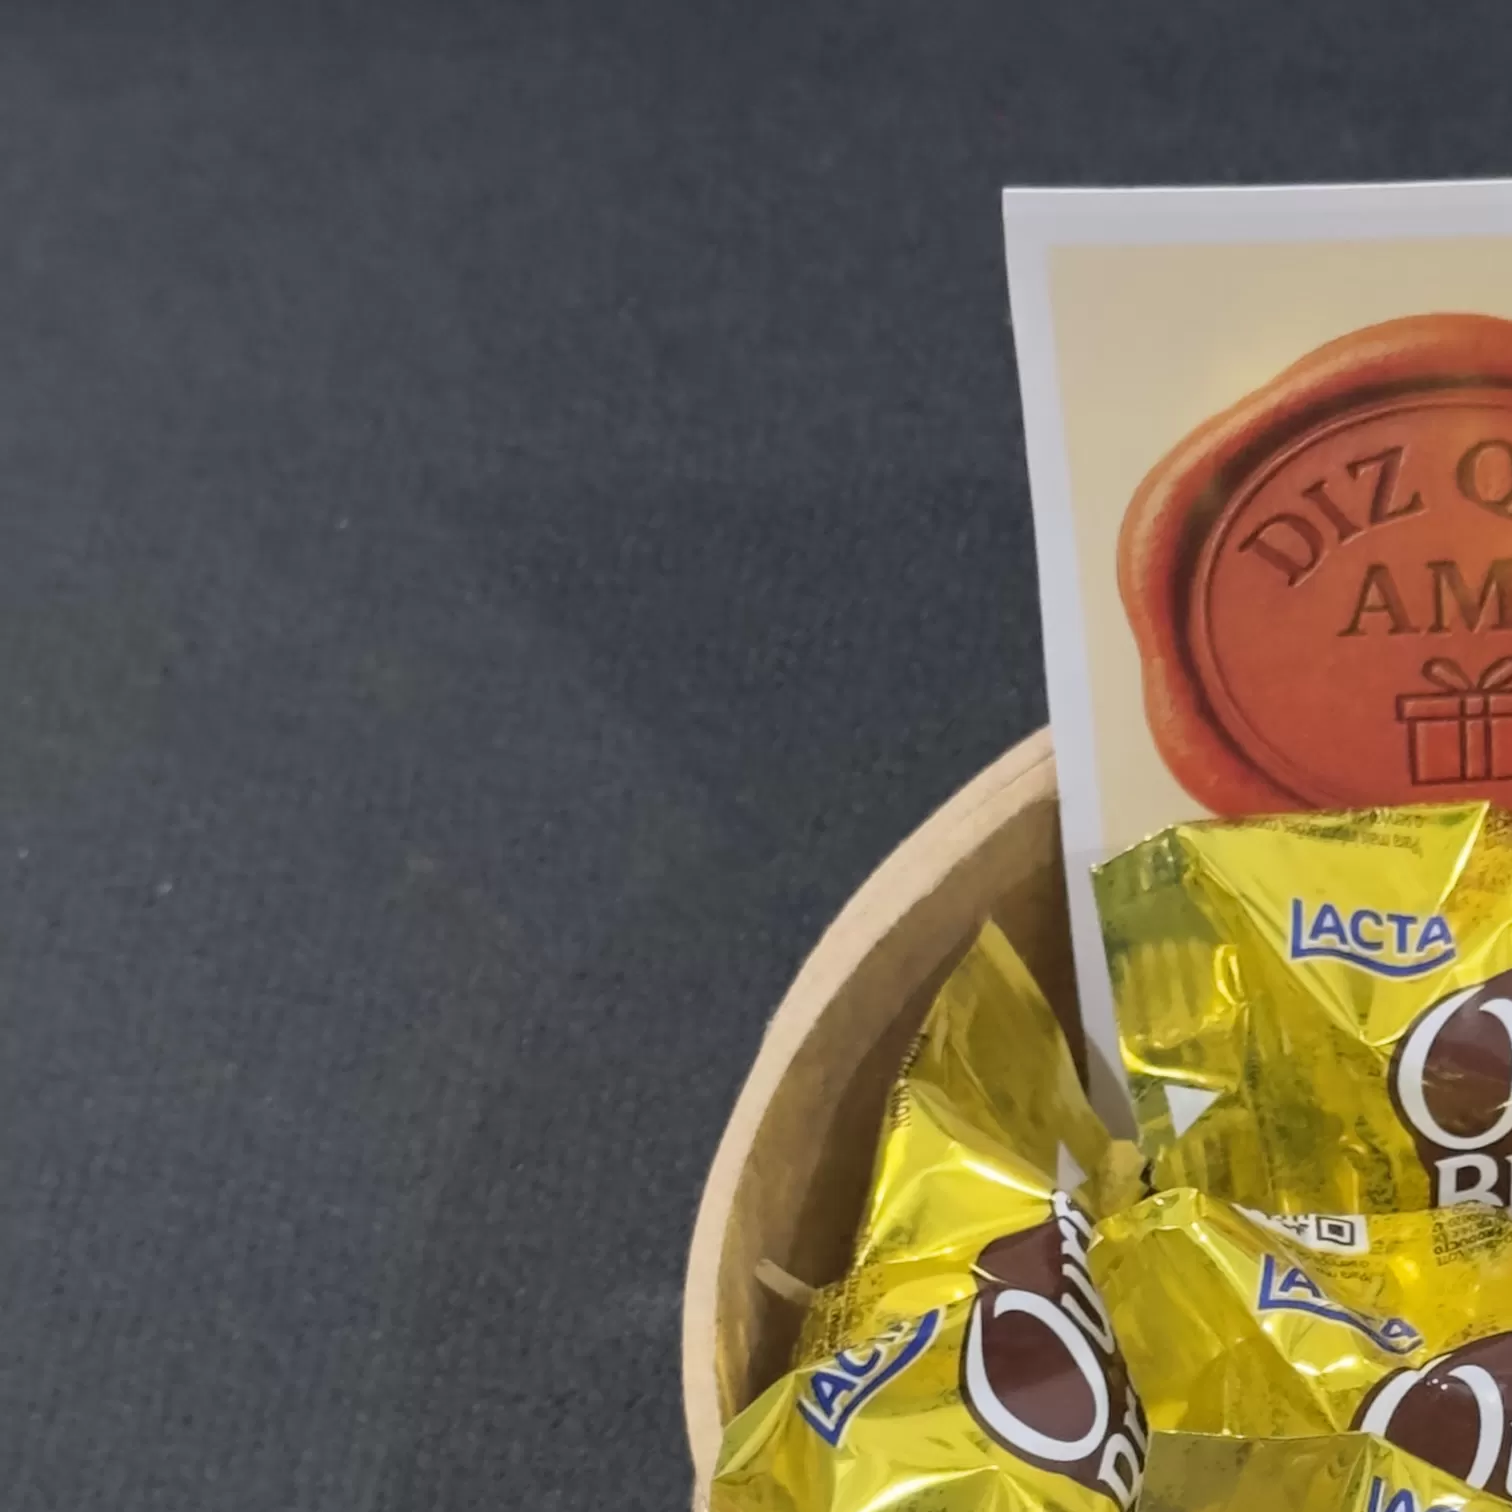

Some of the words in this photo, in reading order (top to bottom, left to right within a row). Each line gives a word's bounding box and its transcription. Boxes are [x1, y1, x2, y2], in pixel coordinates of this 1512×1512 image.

[1237, 446, 1426, 587] DIZ
[1291, 898, 1456, 976] LACTA
[798, 1307, 943, 1448] LAC
